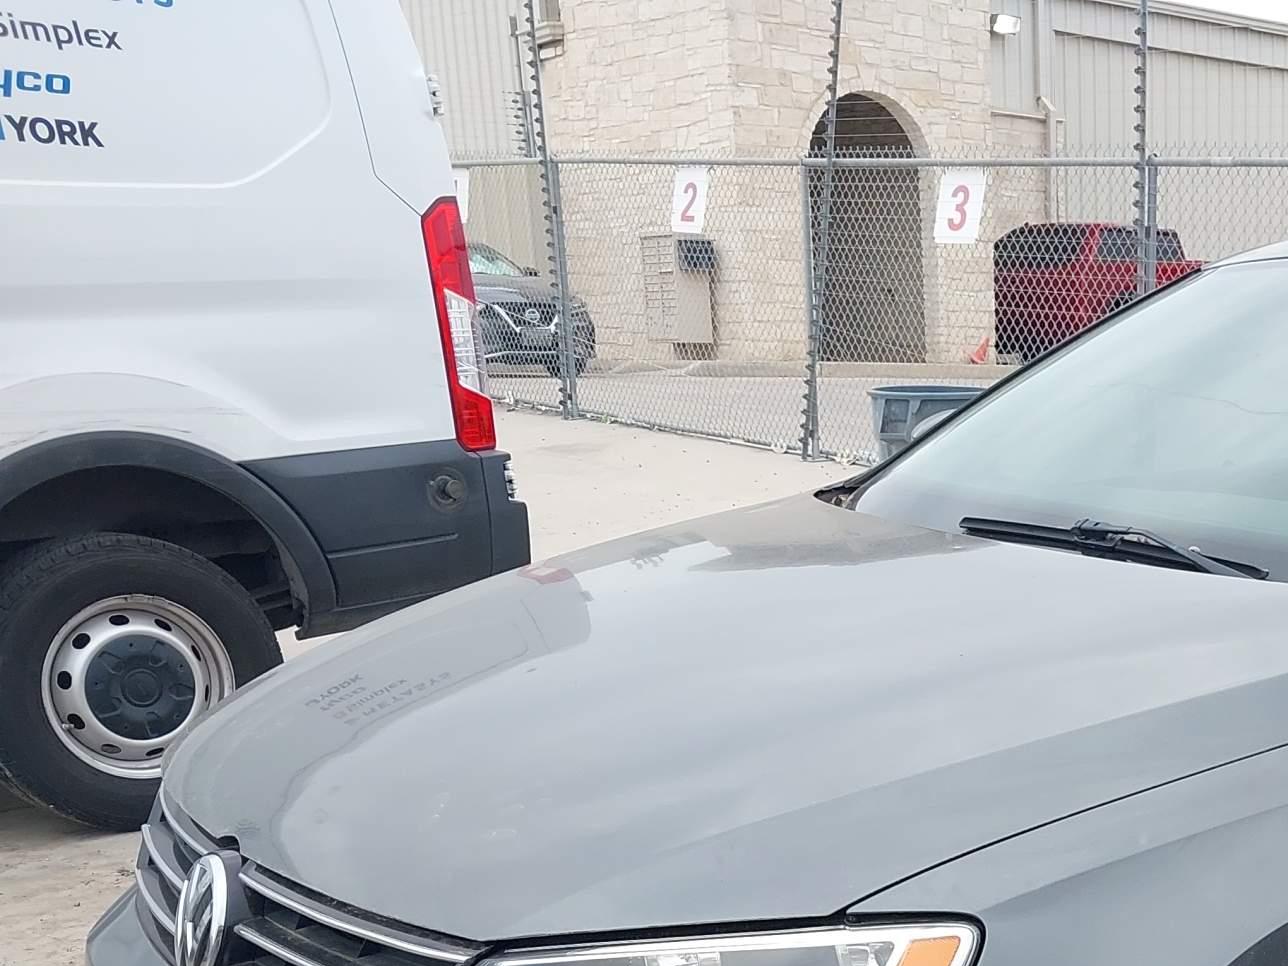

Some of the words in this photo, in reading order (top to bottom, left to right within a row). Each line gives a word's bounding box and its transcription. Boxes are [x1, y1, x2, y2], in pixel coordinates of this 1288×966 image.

[3, 114, 105, 148] YORK
[680, 181, 698, 222] 2
[947, 184, 971, 232] 3
